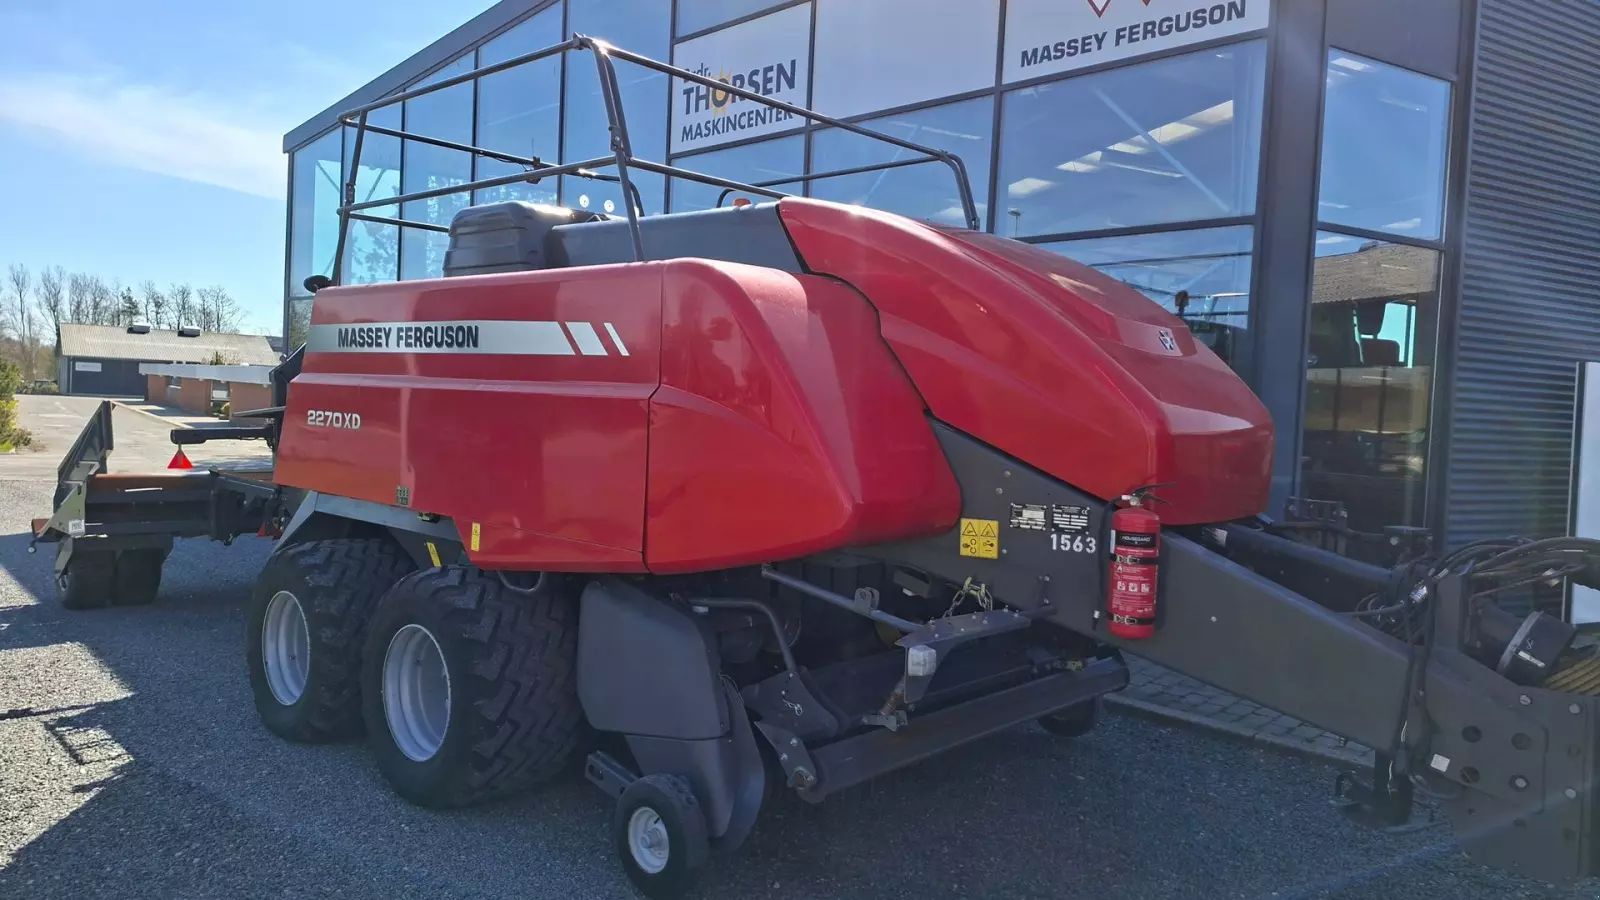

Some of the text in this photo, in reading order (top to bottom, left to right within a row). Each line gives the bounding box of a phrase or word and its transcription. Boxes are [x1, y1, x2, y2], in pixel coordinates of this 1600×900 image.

[1020, 0, 1246, 68] MASSEY FERGUSON
[682, 59, 797, 115] THORSEN
[681, 101, 794, 143] MASKINCENTER
[337, 325, 479, 348] MASSEY FERGUSON
[1050, 533, 1096, 553] 1563
